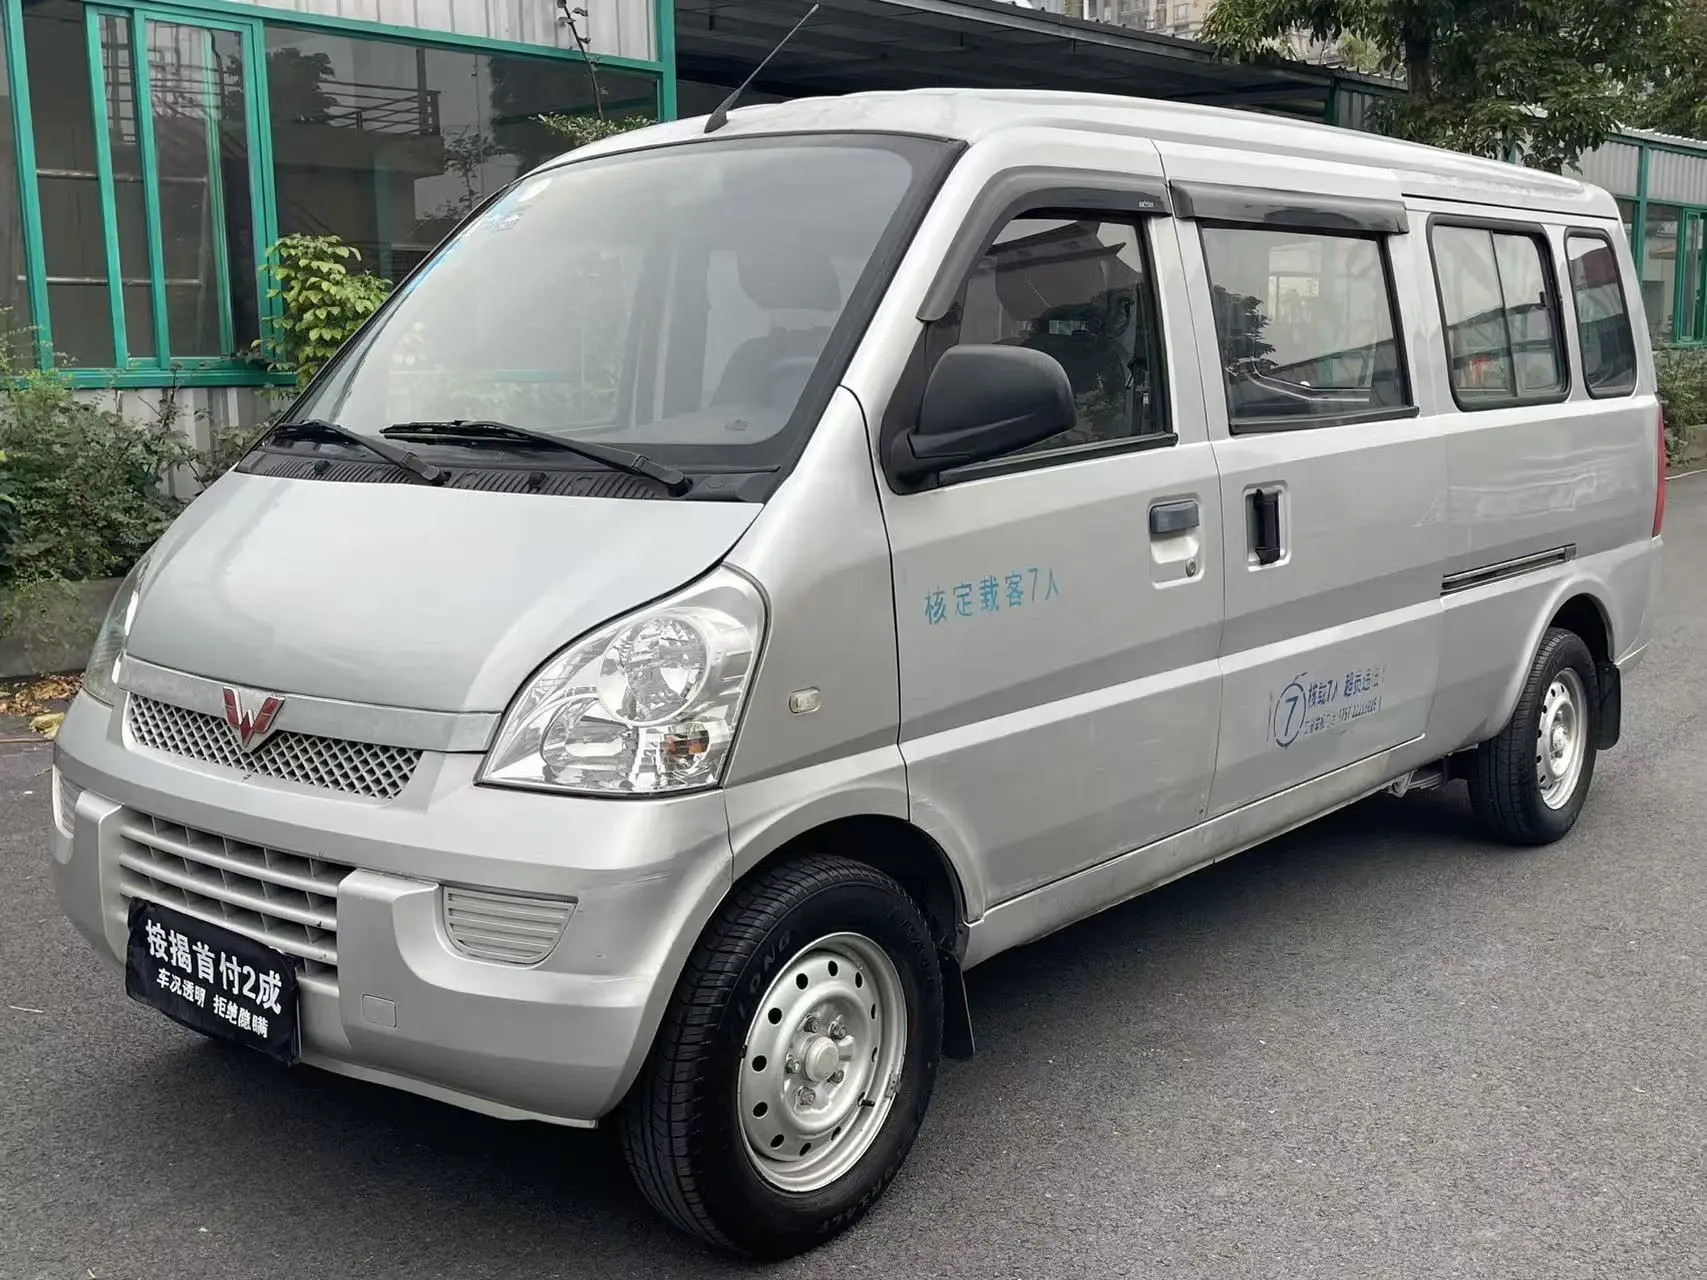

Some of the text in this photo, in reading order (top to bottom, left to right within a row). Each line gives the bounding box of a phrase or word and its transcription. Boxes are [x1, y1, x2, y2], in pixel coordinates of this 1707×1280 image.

[924, 567, 1060, 625] 核定载客7人
[145, 919, 283, 1014] 按揭首付2成
[156, 968, 269, 1038] 车况透明 拒绝隐瞒
